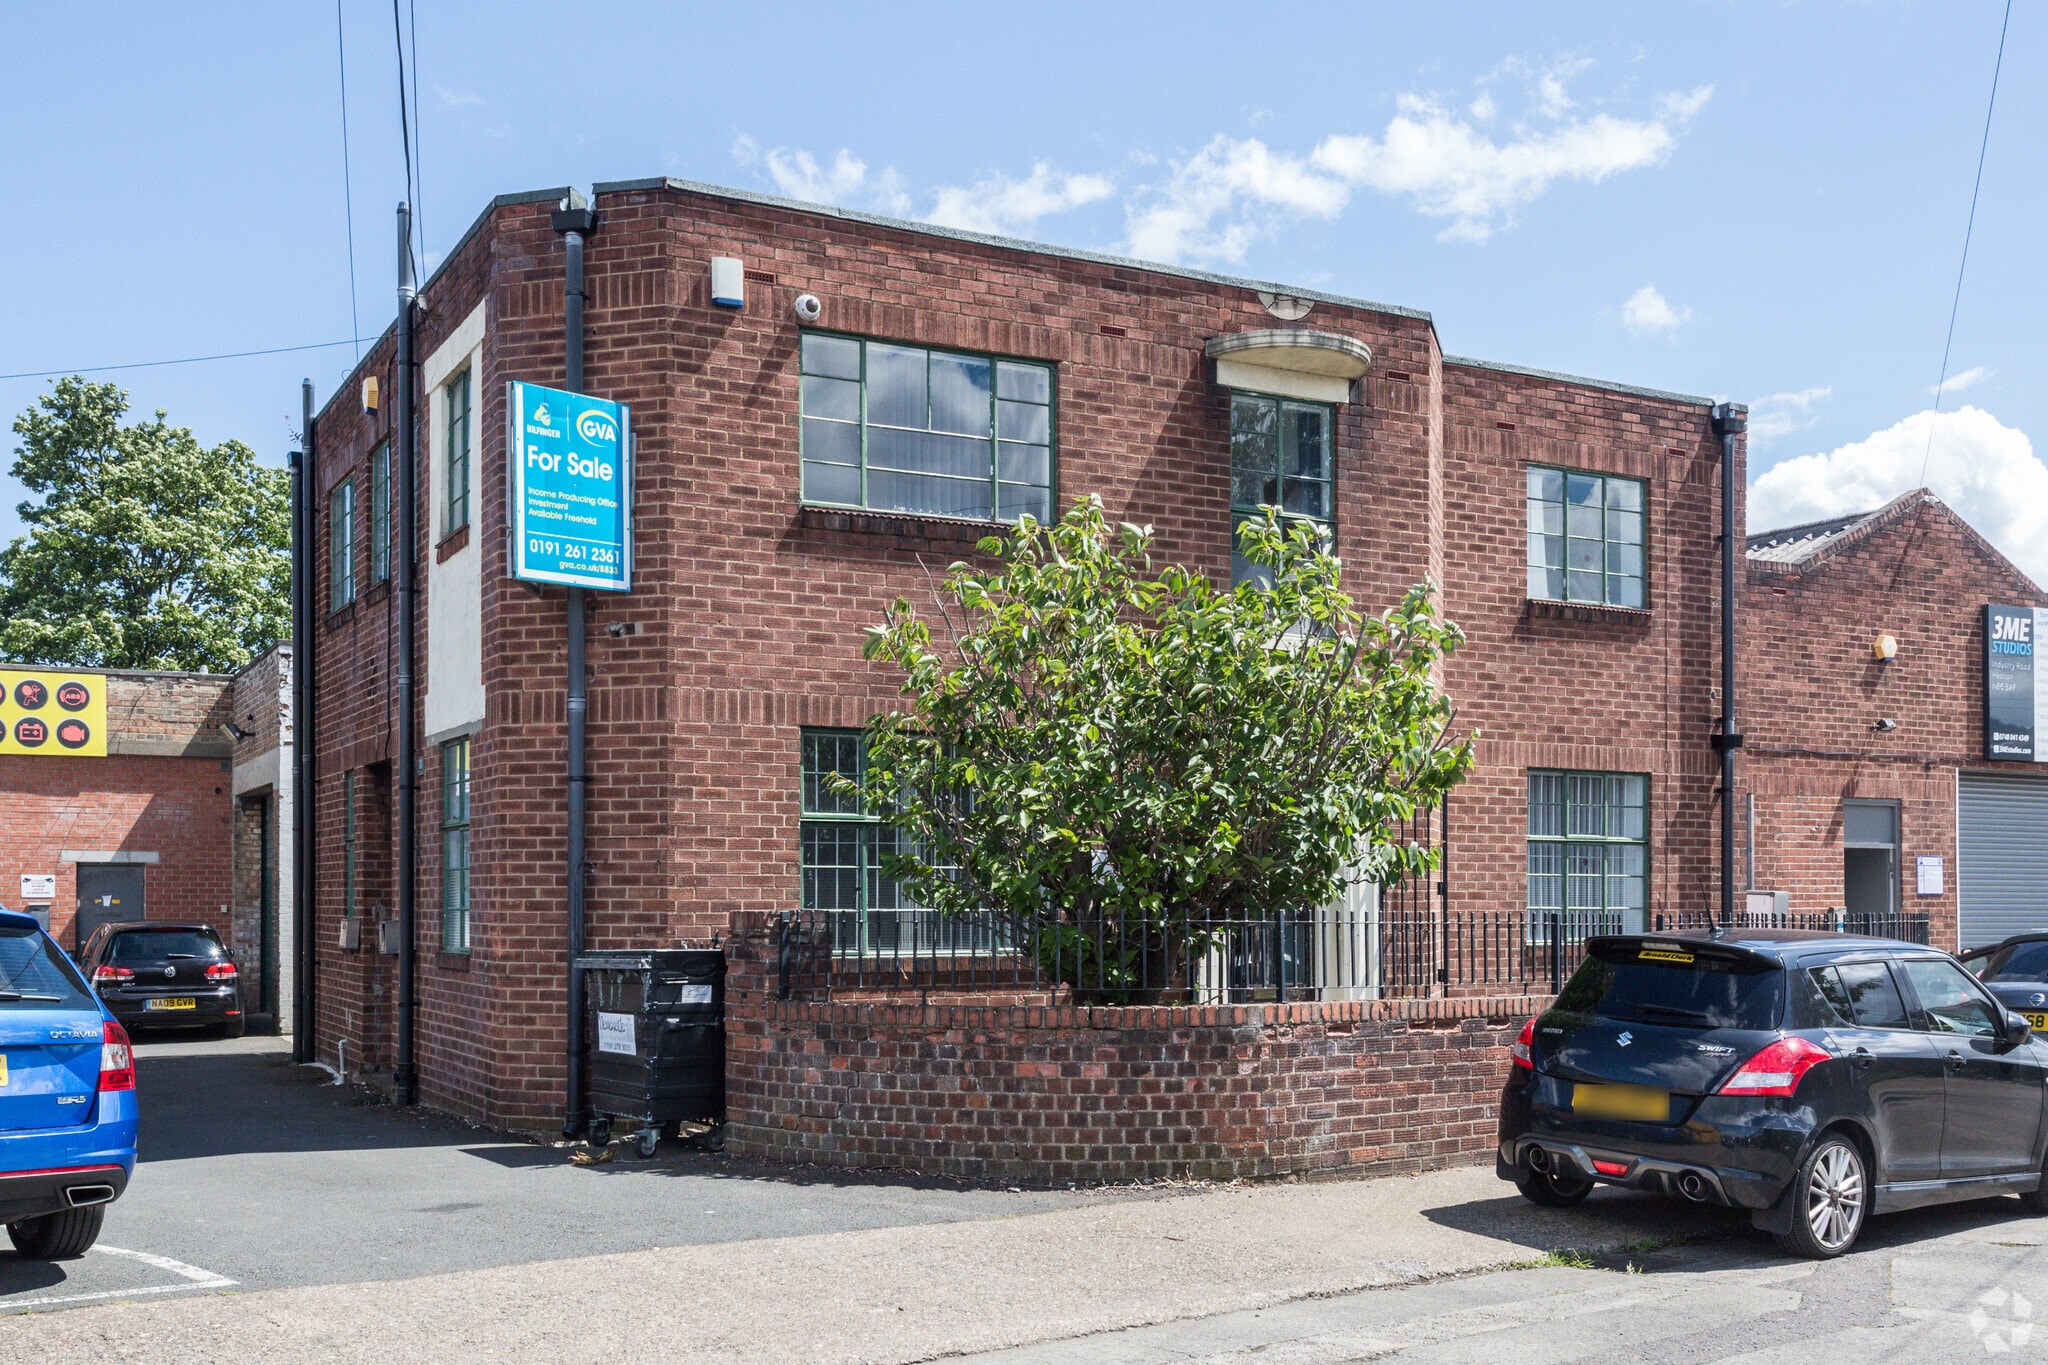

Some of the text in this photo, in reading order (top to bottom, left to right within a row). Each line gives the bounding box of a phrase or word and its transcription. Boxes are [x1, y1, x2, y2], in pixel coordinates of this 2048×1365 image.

[527, 424, 561, 439] BILFINGER
[582, 420, 617, 442] GVA
[528, 444, 613, 481] For Sale
[528, 486, 618, 508] Income Producing Office
[528, 497, 569, 510] Investment
[528, 508, 597, 525] Available Freehold
[530, 539, 619, 564] 0191 261 2361
[1992, 615, 2031, 641] 3ME
[1992, 640, 2032, 656] STUDIOS
[151, 998, 195, 1008] NA09 GVR
[50, 1030, 98, 1039] OCTAVIA
[1697, 1044, 1736, 1053] SWIFT
